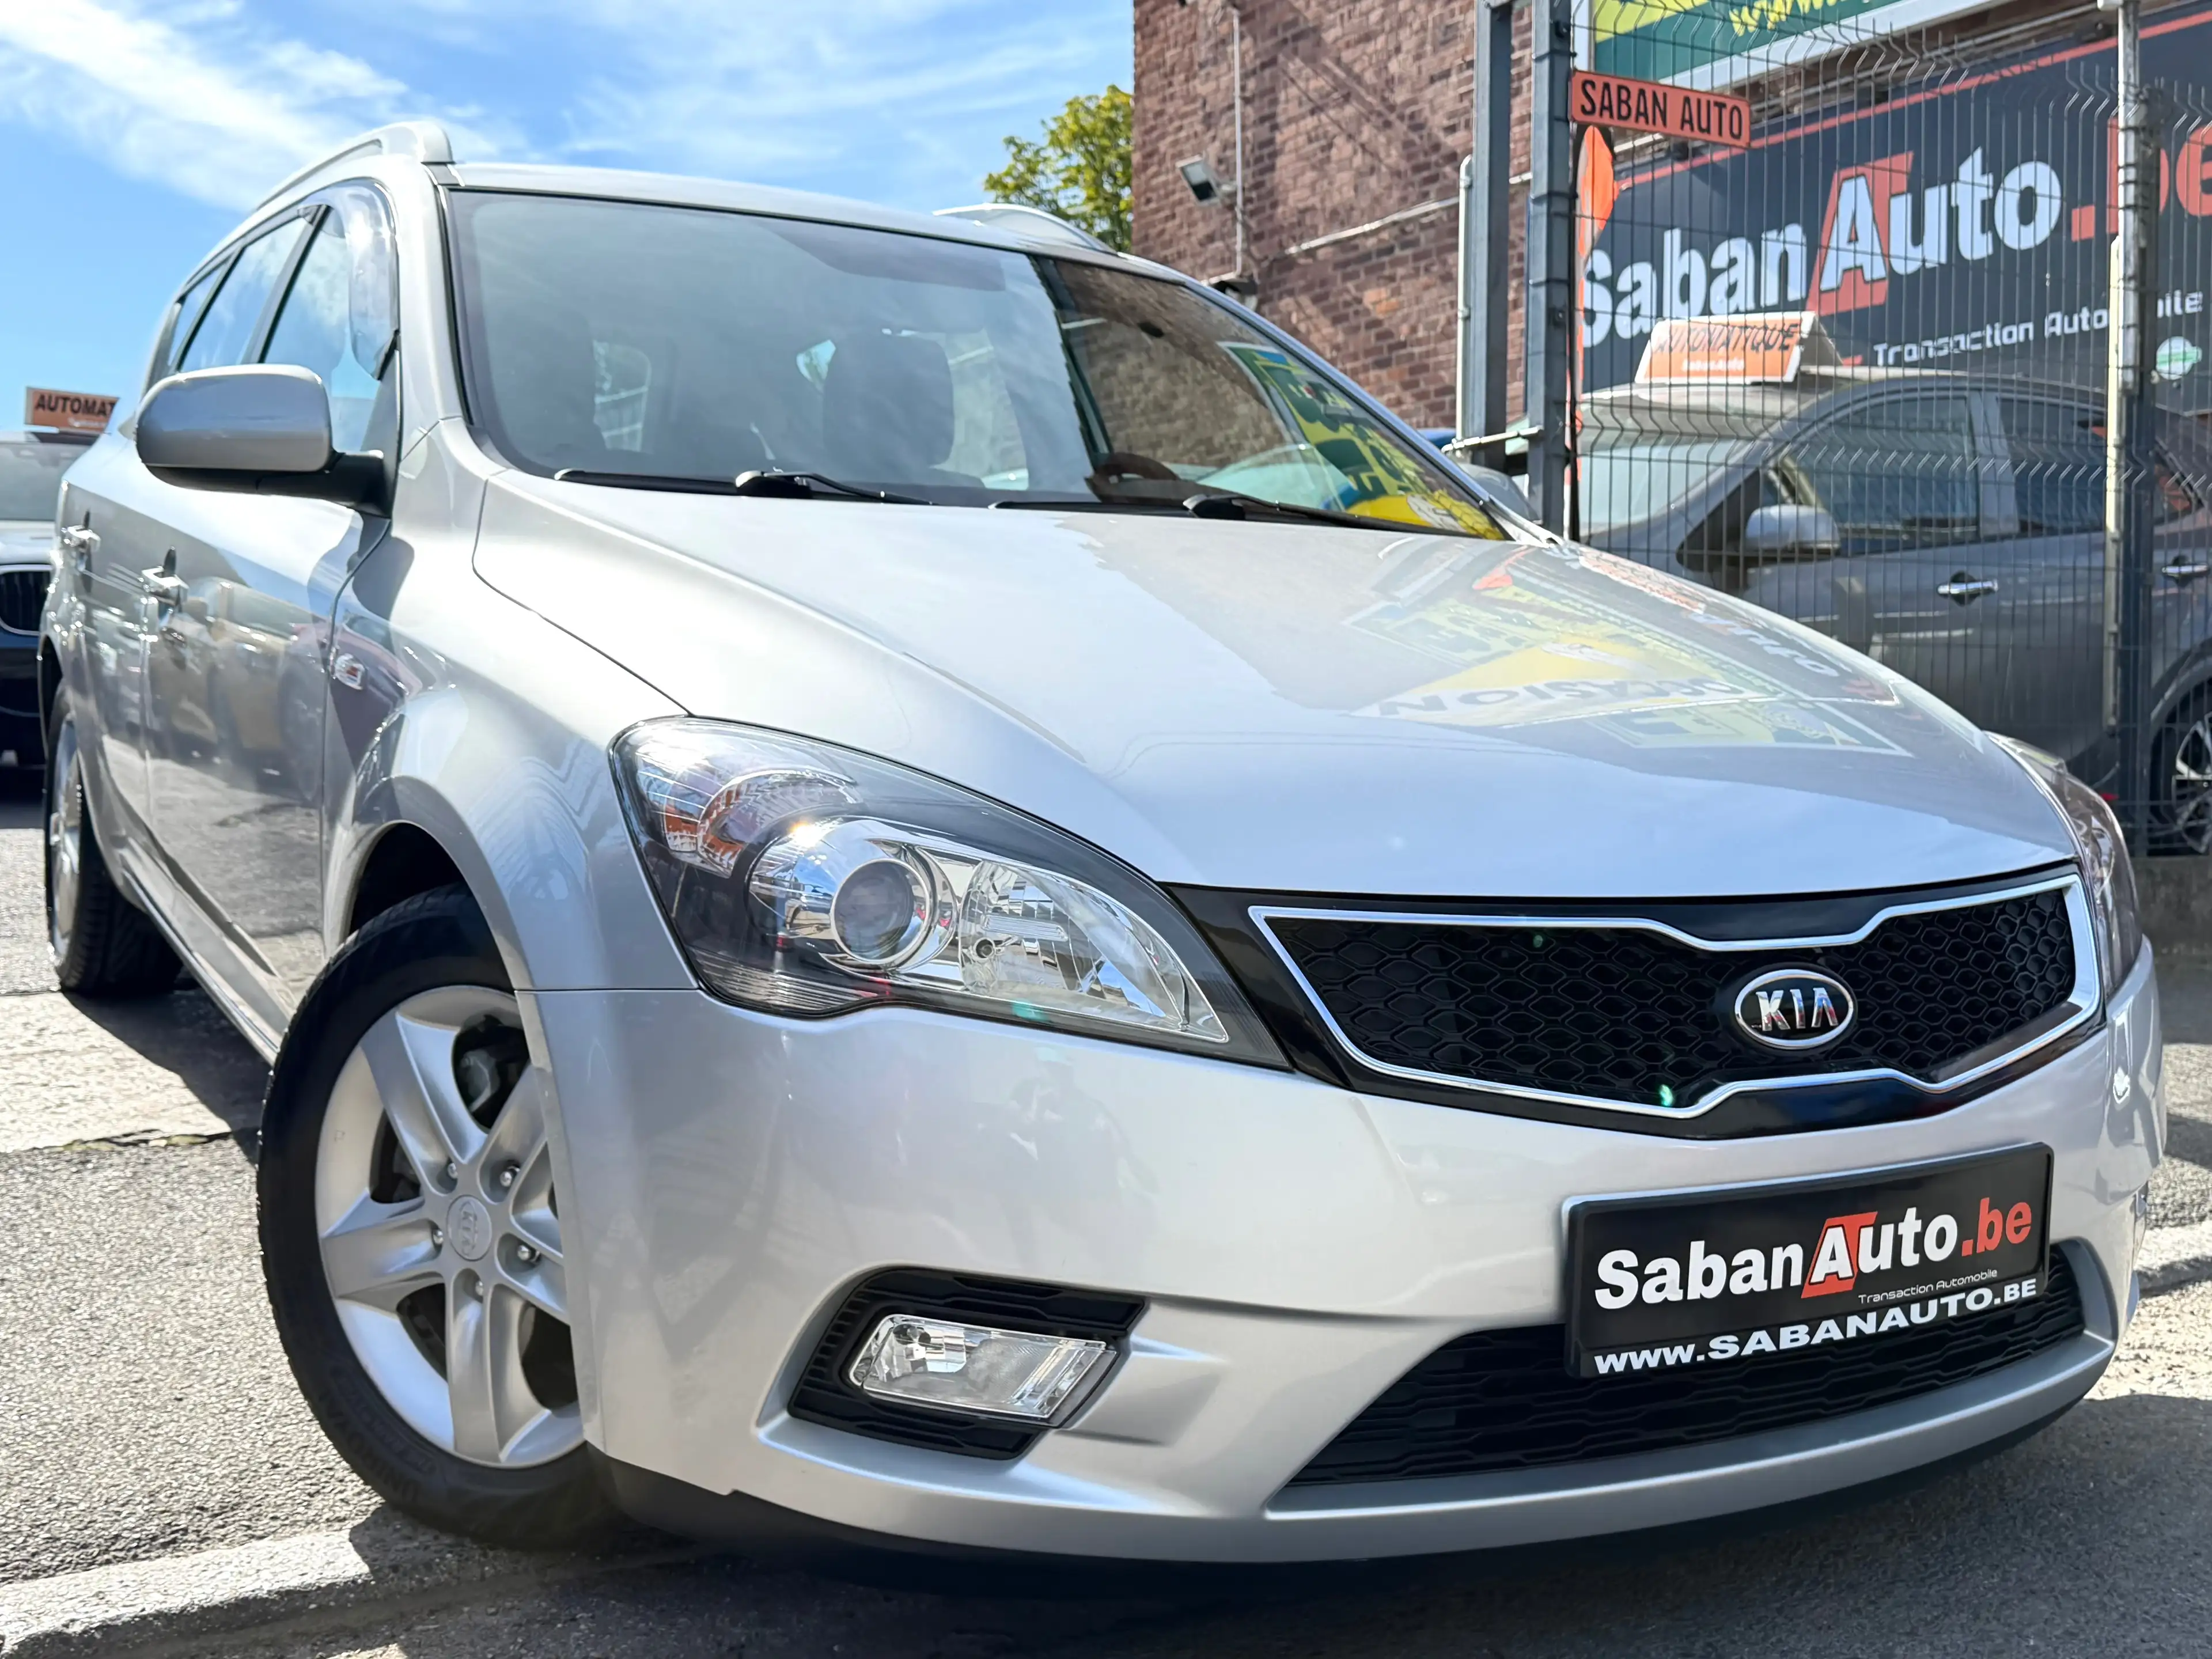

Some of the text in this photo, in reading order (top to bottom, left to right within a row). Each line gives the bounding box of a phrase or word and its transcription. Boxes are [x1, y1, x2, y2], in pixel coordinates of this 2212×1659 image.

[1581, 79, 1743, 140] SABAN AUTO
[1873, 290, 2204, 367] Transaction Autoile
[1756, 987, 1839, 1031] KIA
[1594, 1197, 2032, 1310] SabanAuto.be
[1858, 1268, 1998, 1305] Transaction Automobile
[1594, 1278, 2037, 1374] www.SABANAUTO.BE
